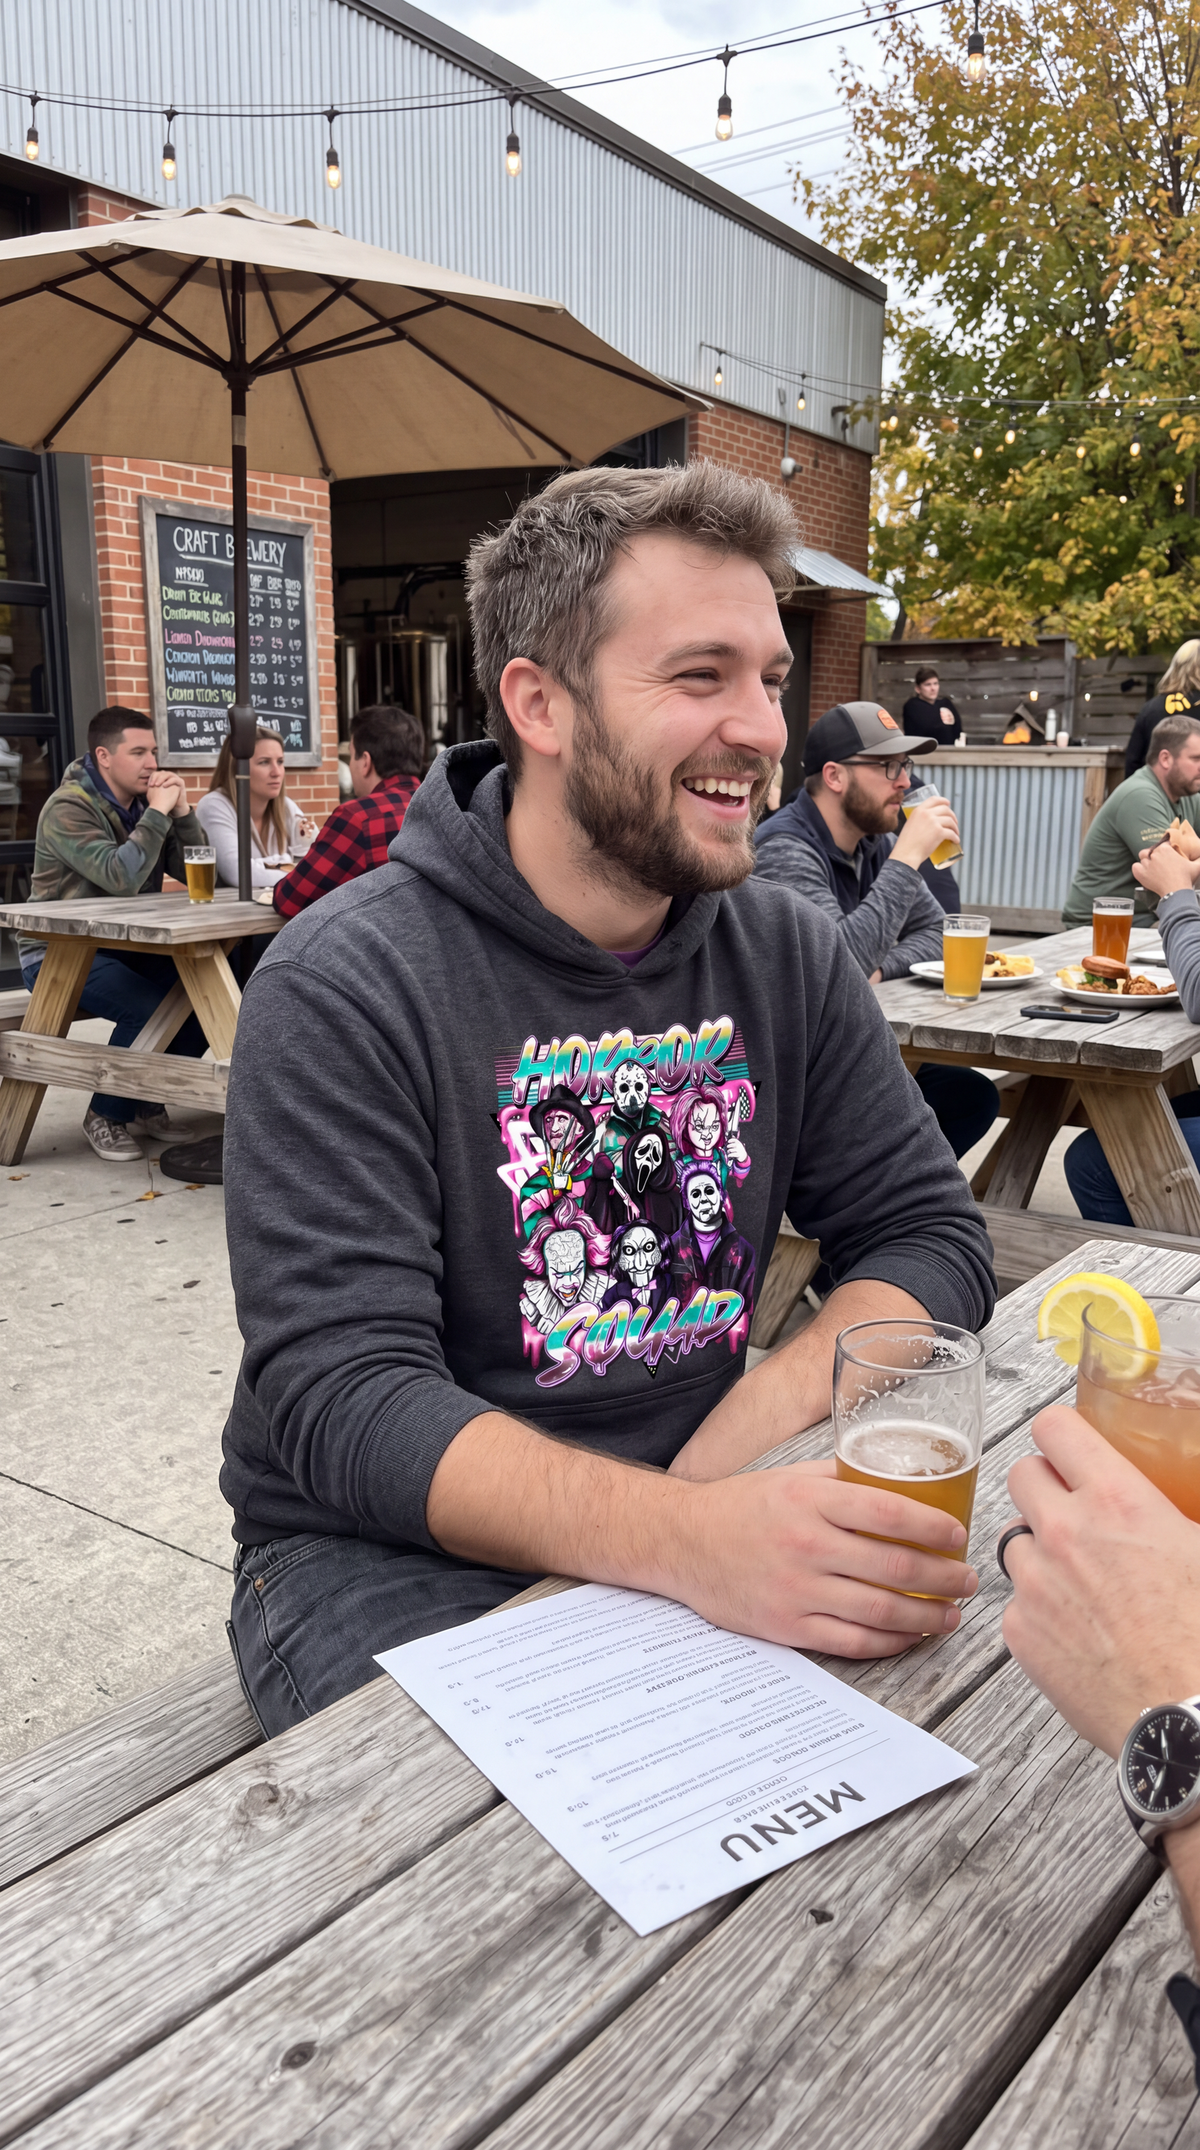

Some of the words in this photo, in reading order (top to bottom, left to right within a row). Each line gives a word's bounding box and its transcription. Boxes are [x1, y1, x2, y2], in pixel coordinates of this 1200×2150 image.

[173, 526, 220, 556] CRAFT
[225, 533, 287, 568] BEWERY
[535, 1286, 746, 1389] SQUAD
[720, 1781, 867, 1863] MENU
